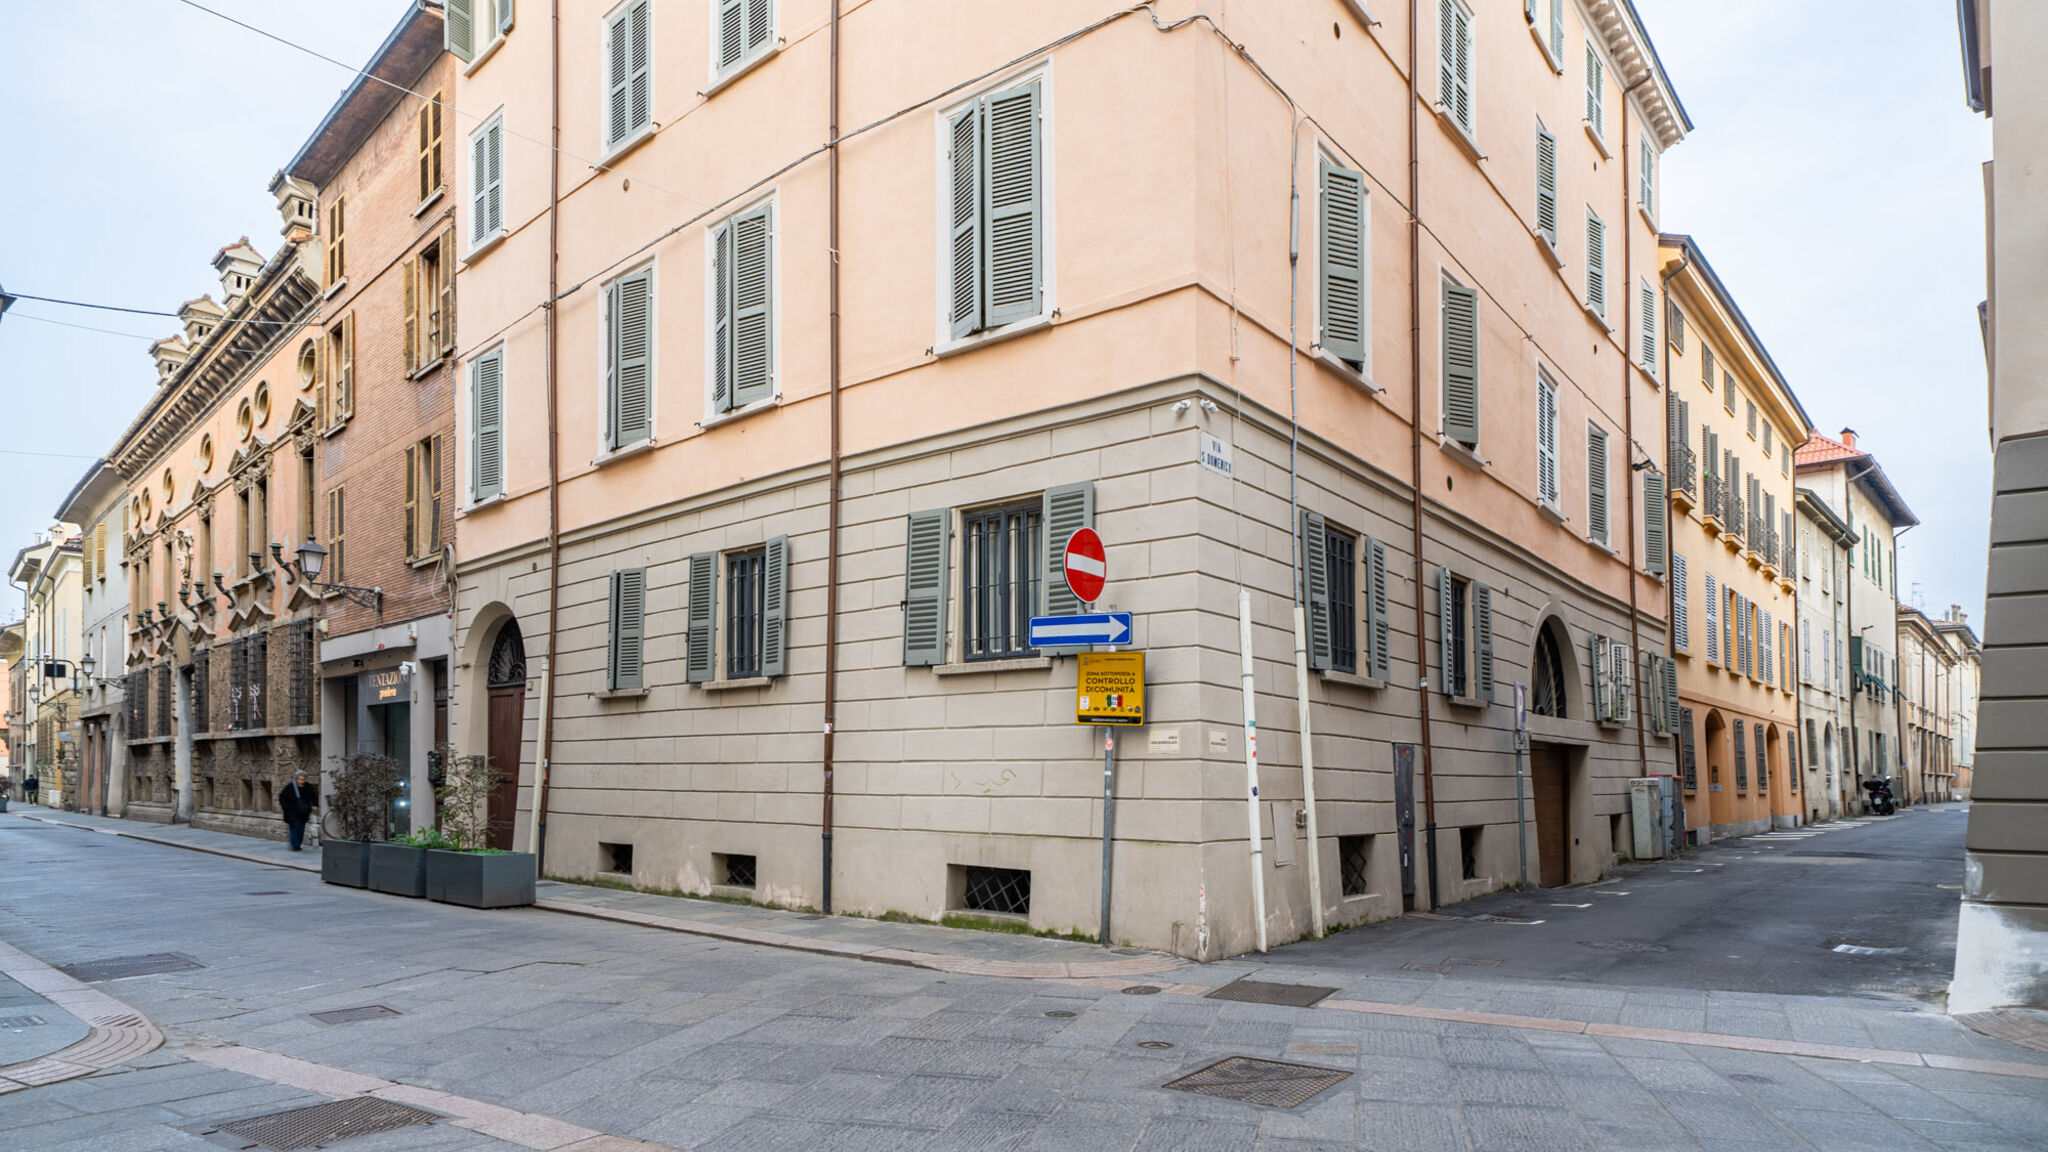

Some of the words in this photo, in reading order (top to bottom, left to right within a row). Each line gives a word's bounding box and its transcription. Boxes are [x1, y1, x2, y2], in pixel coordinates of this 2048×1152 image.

[1212, 440, 1221, 453] VIA
[1207, 453, 1232, 473] DOMENICO
[1086, 677, 1136, 685] CONTROLLO
[1094, 684, 1135, 693] COMUNITÀ
